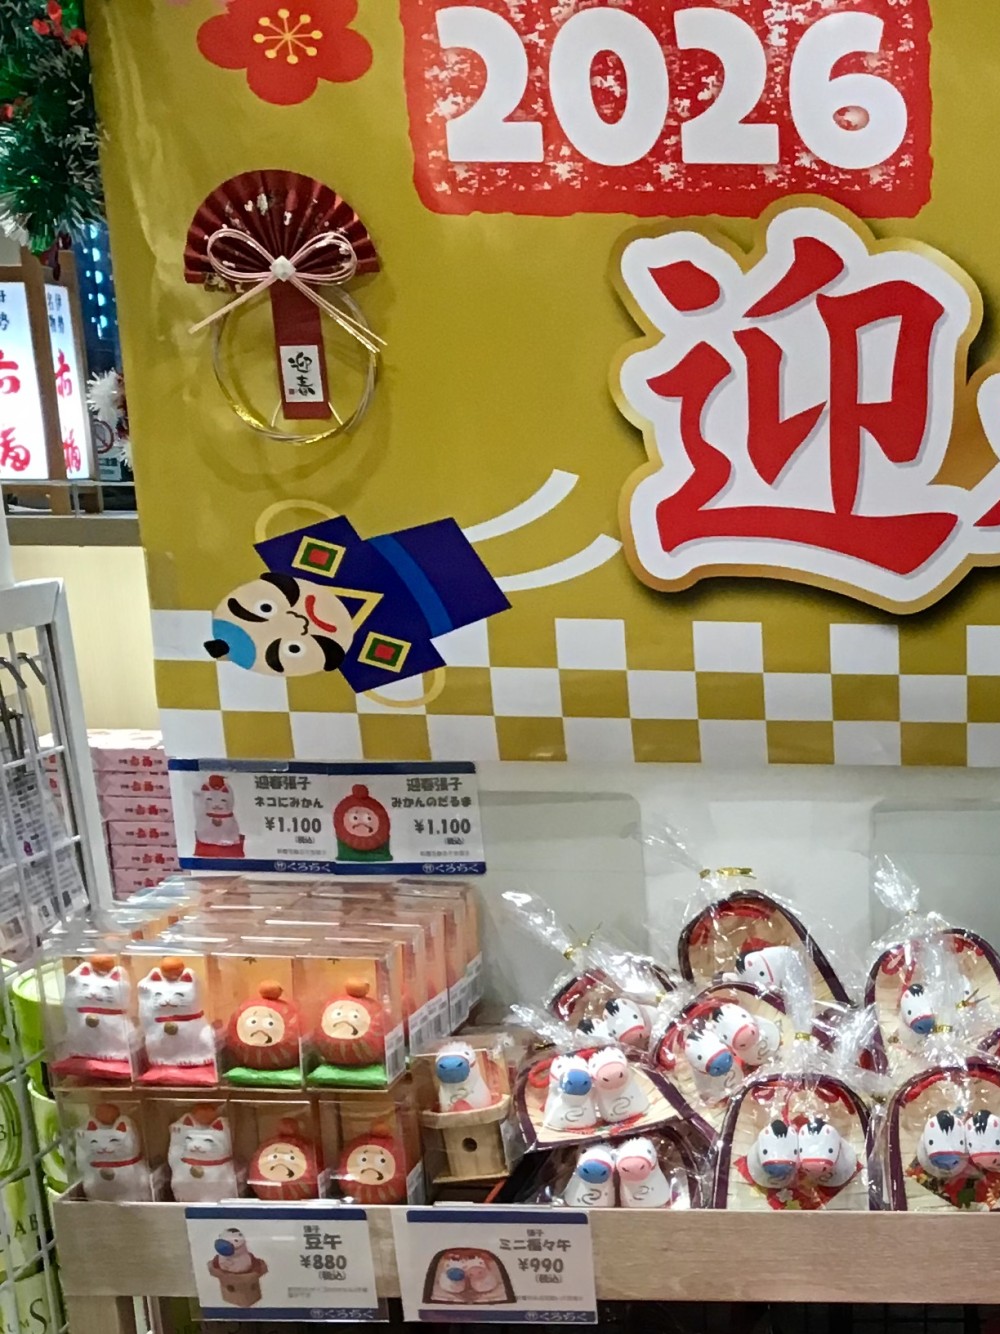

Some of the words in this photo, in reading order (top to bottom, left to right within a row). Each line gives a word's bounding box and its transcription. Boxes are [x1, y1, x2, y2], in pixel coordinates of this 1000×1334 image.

[436, 6, 907, 169] 2026
[254, 795, 324, 809] ネコにみかん
[391, 796, 472, 808] みかんのだるま
[304, 1233, 342, 1250] 豆午
[300, 1254, 347, 1271] ¥880
[518, 1257, 564, 1273] ¥990
